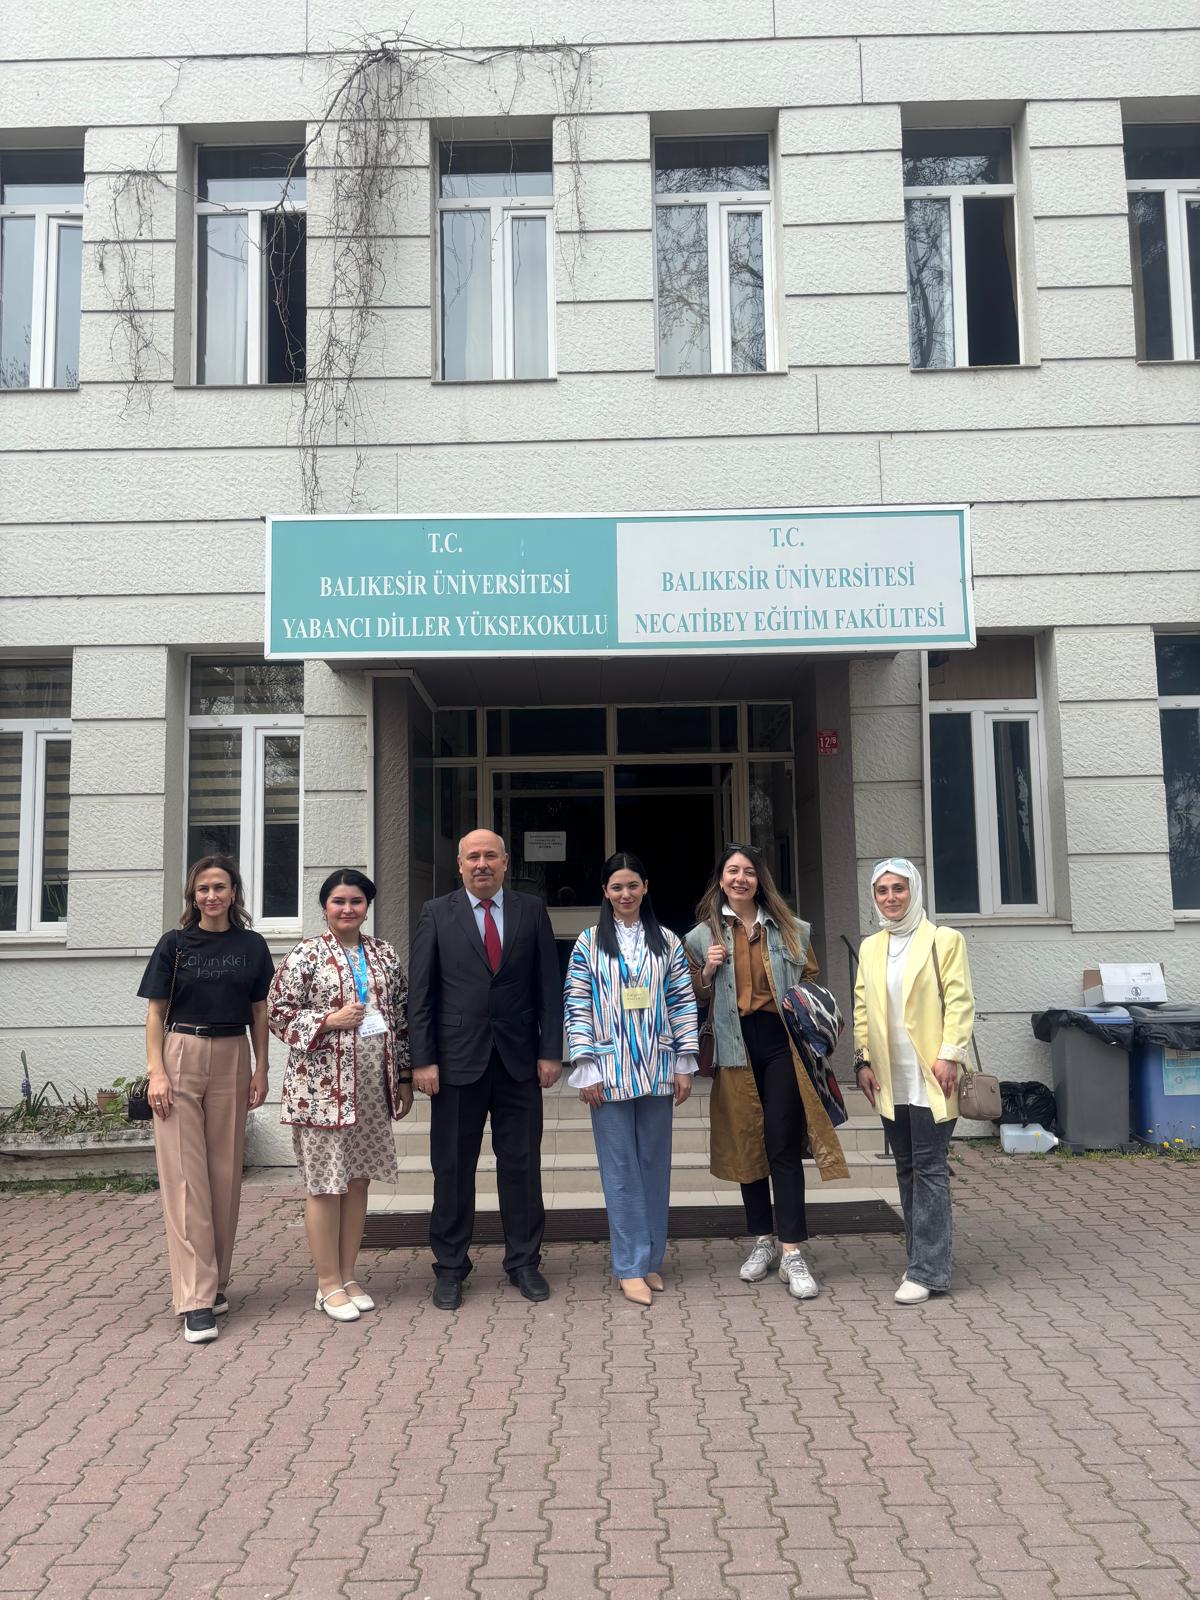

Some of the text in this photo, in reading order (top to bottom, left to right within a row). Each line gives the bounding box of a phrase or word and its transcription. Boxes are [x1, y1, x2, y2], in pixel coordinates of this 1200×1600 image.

[427, 532, 463, 553] T.C.
[769, 527, 804, 547] T.C.
[319, 568, 571, 597] BALIKESİR ÜNİVERSİTESİ
[661, 561, 916, 592] BALIKESİR ÜNİVERSİTESİ
[282, 610, 608, 639] YABANCI DİLLER YÜKSEKOKULU
[635, 601, 945, 634] NECATİBEY EĞİTİM FAKÜLTESİ
